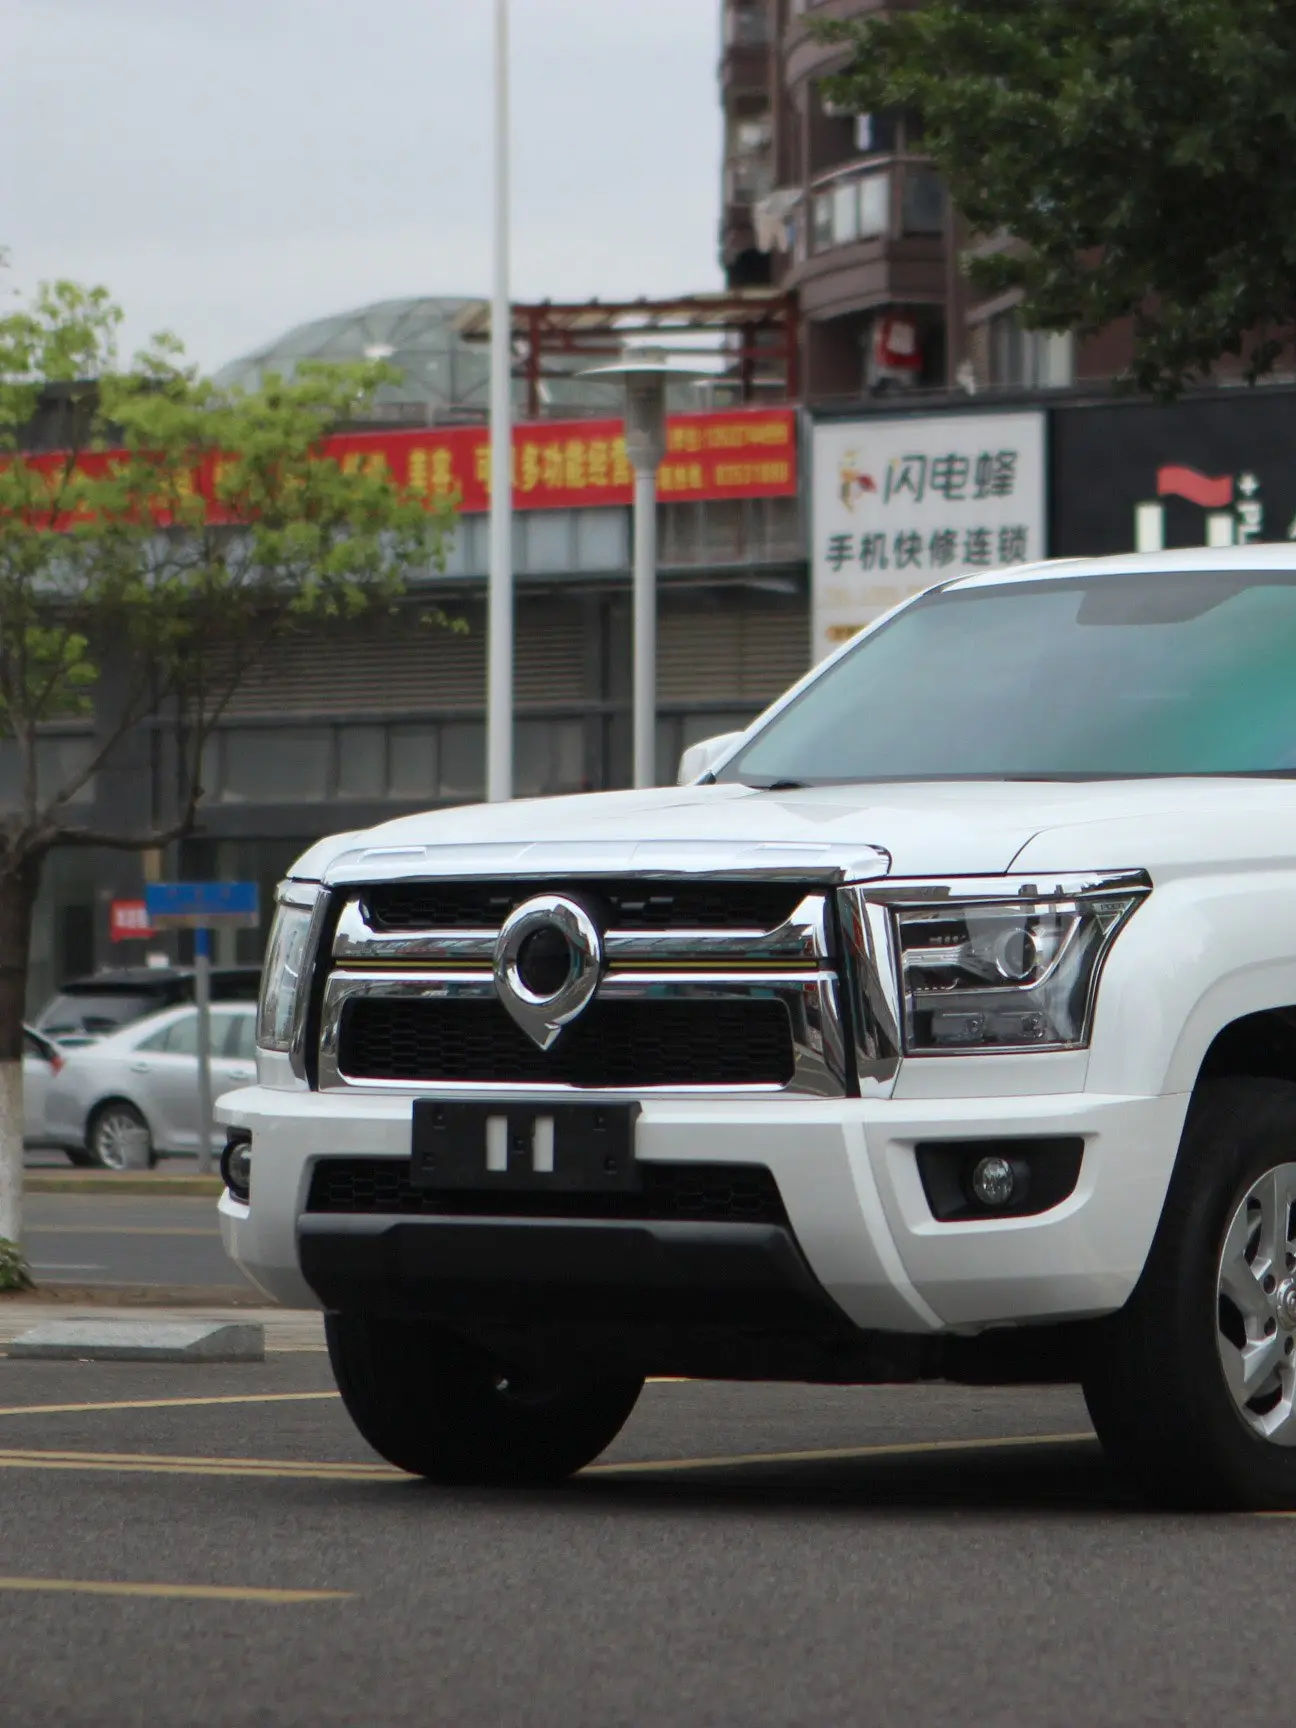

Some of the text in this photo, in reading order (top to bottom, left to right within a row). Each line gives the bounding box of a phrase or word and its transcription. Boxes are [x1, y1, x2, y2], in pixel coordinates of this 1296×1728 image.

[883, 449, 1017, 504] 闪电蜂
[825, 525, 1028, 571] 手机快修连锁
